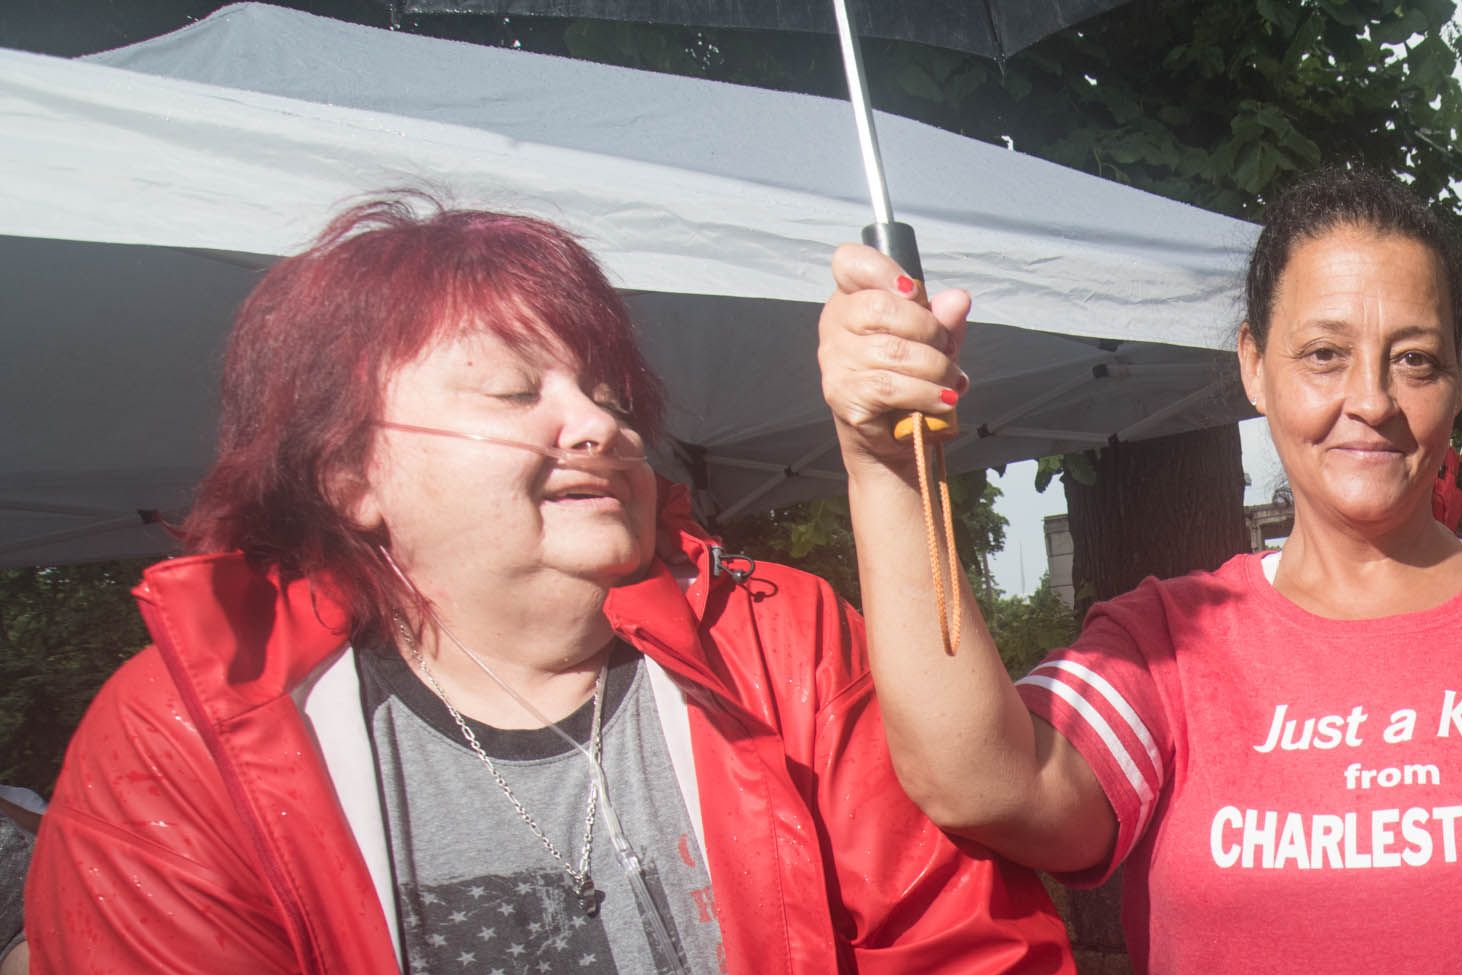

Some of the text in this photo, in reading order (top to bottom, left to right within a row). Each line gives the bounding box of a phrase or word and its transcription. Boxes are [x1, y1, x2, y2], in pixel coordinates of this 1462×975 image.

[1253, 704, 1368, 753] Just
[1383, 708, 1417, 743] a
[1344, 763, 1440, 789] from
